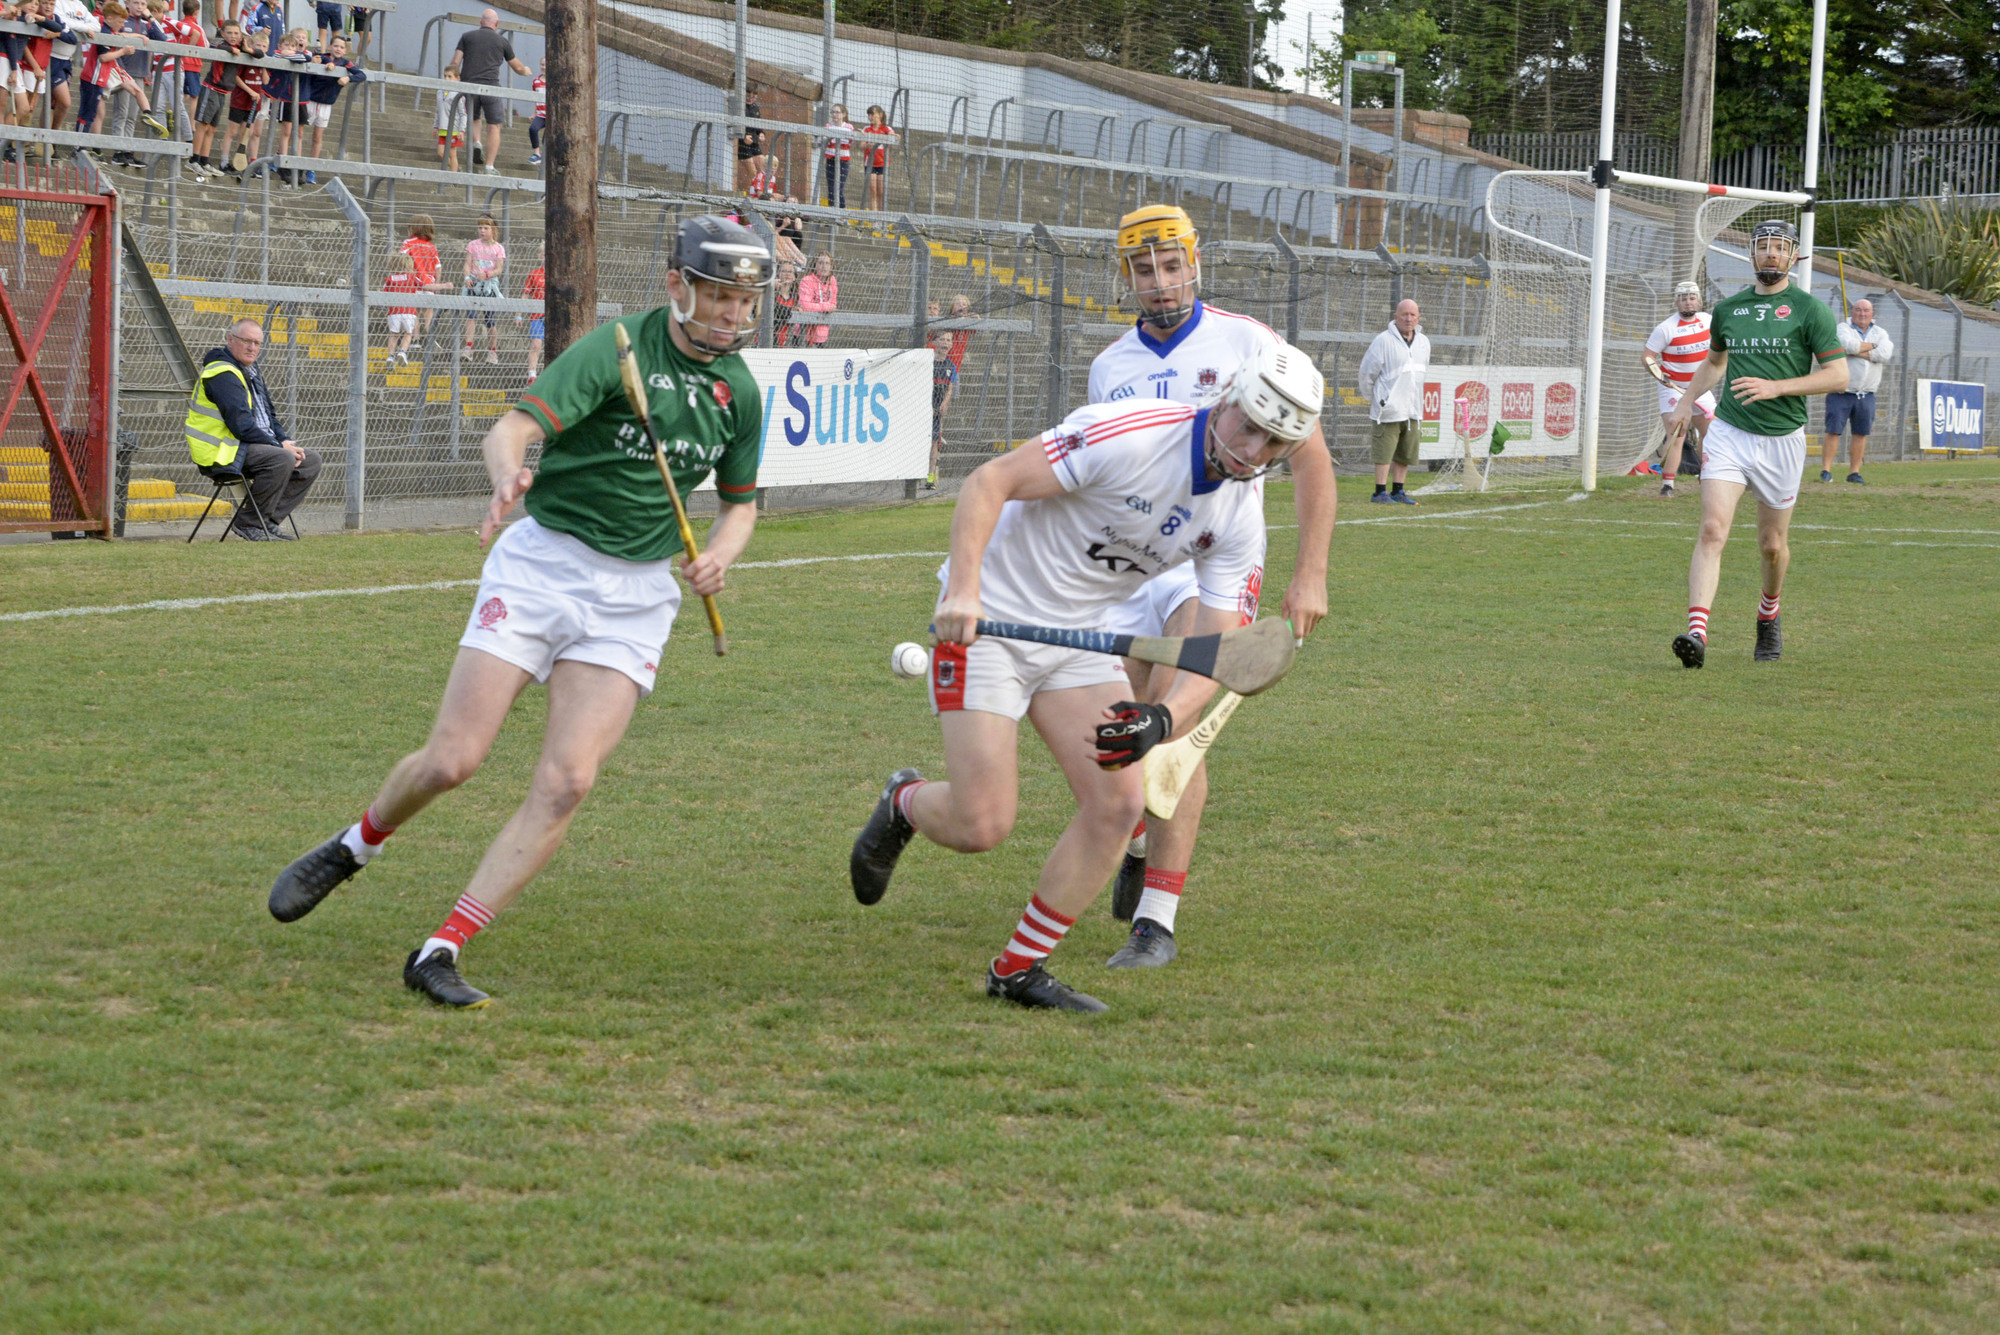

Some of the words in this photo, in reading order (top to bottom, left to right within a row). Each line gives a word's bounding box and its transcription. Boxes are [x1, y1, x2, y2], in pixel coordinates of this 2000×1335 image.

[1755, 309, 1766, 321] 3
[1725, 338, 1791, 347] BLARNEY
[1147, 368, 1178, 381] oneills
[1156, 380, 1168, 400] 11
[1945, 396, 1982, 435] Dulux
[1160, 515, 1181, 536] 8
